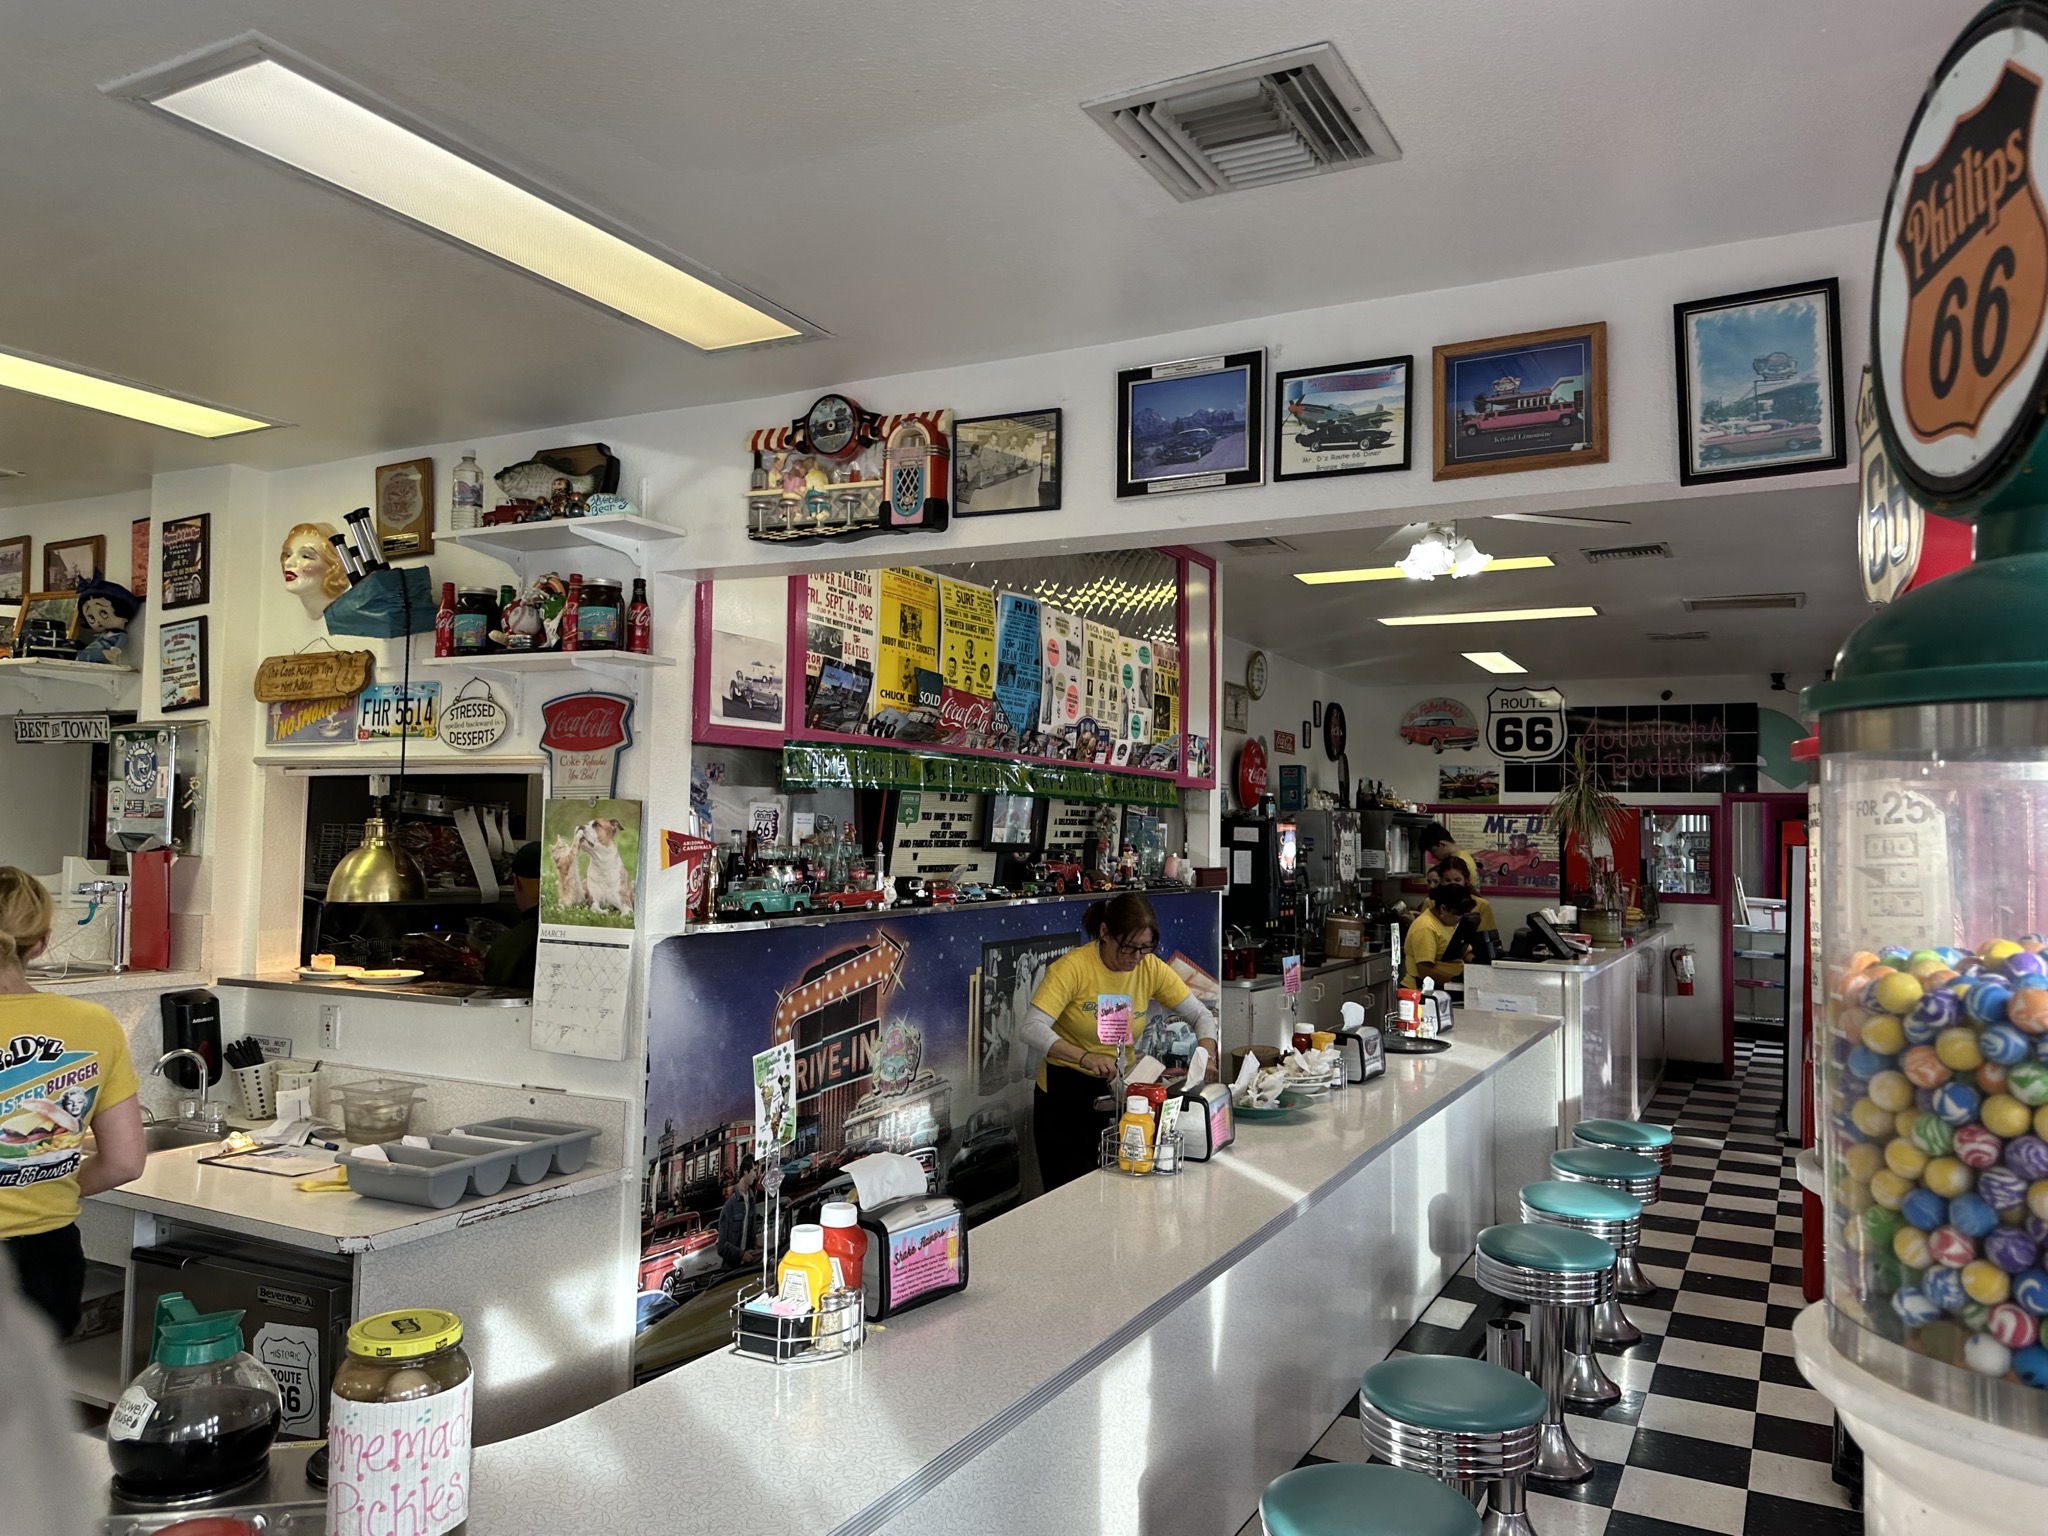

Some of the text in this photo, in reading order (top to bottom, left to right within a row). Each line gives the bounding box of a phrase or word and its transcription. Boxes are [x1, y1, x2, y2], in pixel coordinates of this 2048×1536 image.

[1905, 124, 2025, 282] Phillips
[1930, 243, 2016, 400] 66
[1302, 456, 1314, 464] Mr.
[1363, 450, 1382, 458] Diner
[591, 503, 616, 516] Bear
[854, 570, 866, 581] BEAT
[838, 575, 872, 598] BALLROOM
[826, 592, 845, 612] SEPT.
[956, 590, 975, 607] SURF
[844, 642, 870, 660] BEATLES
[280, 663, 295, 677] Cook
[321, 661, 334, 677] Tips
[880, 689, 905, 702] CHUCK
[919, 690, 941, 707] SOLD
[1501, 697, 1548, 709] ROUTE
[362, 698, 390, 727] FHR
[450, 701, 495, 721] STRESSED
[940, 696, 992, 734] Coca-Cola
[995, 711, 1005, 723] ICE
[20, 721, 103, 739] BEST IN TOWN
[277, 715, 295, 741] NO
[445, 720, 464, 730] spelled
[464, 718, 493, 729] backward
[550, 707, 616, 740] Coca-Cola
[991, 720, 1009, 734] COLD
[449, 728, 495, 746] DESSERTS
[1496, 716, 1553, 752] 66
[560, 755, 581, 767] Coke
[568, 768, 579, 784] You
[756, 812, 773, 820] ROUTE
[1856, 791, 1930, 825] FOR .25
[921, 812, 932, 820] YOU
[934, 812, 947, 821] HAVE
[957, 813, 973, 822] TASTE
[1483, 815, 1519, 833] Mr.
[755, 821, 771, 837] 66
[941, 822, 952, 830] OUR
[930, 831, 967, 839] GREAT SHAKES
[899, 840, 911, 848] AND
[912, 840, 933, 848] FAMOUS
[541, 929, 567, 938] MARCH
[264, 1046, 281, 1054] HANDS
[795, 1029, 876, 1093] RIVE-IN
[0, 1061, 99, 1117] STER BURGER
[19, 1168, 38, 1186] 66
[38, 1164, 73, 1179] DINER
[893, 1245, 917, 1266] Shake
[270, 1349, 302, 1362] HISTORIC
[271, 1369, 302, 1385] ROUTE
[278, 1385, 301, 1413] 66
[114, 1411, 133, 1427] ouse
[330, 1472, 465, 1536] Pickles
